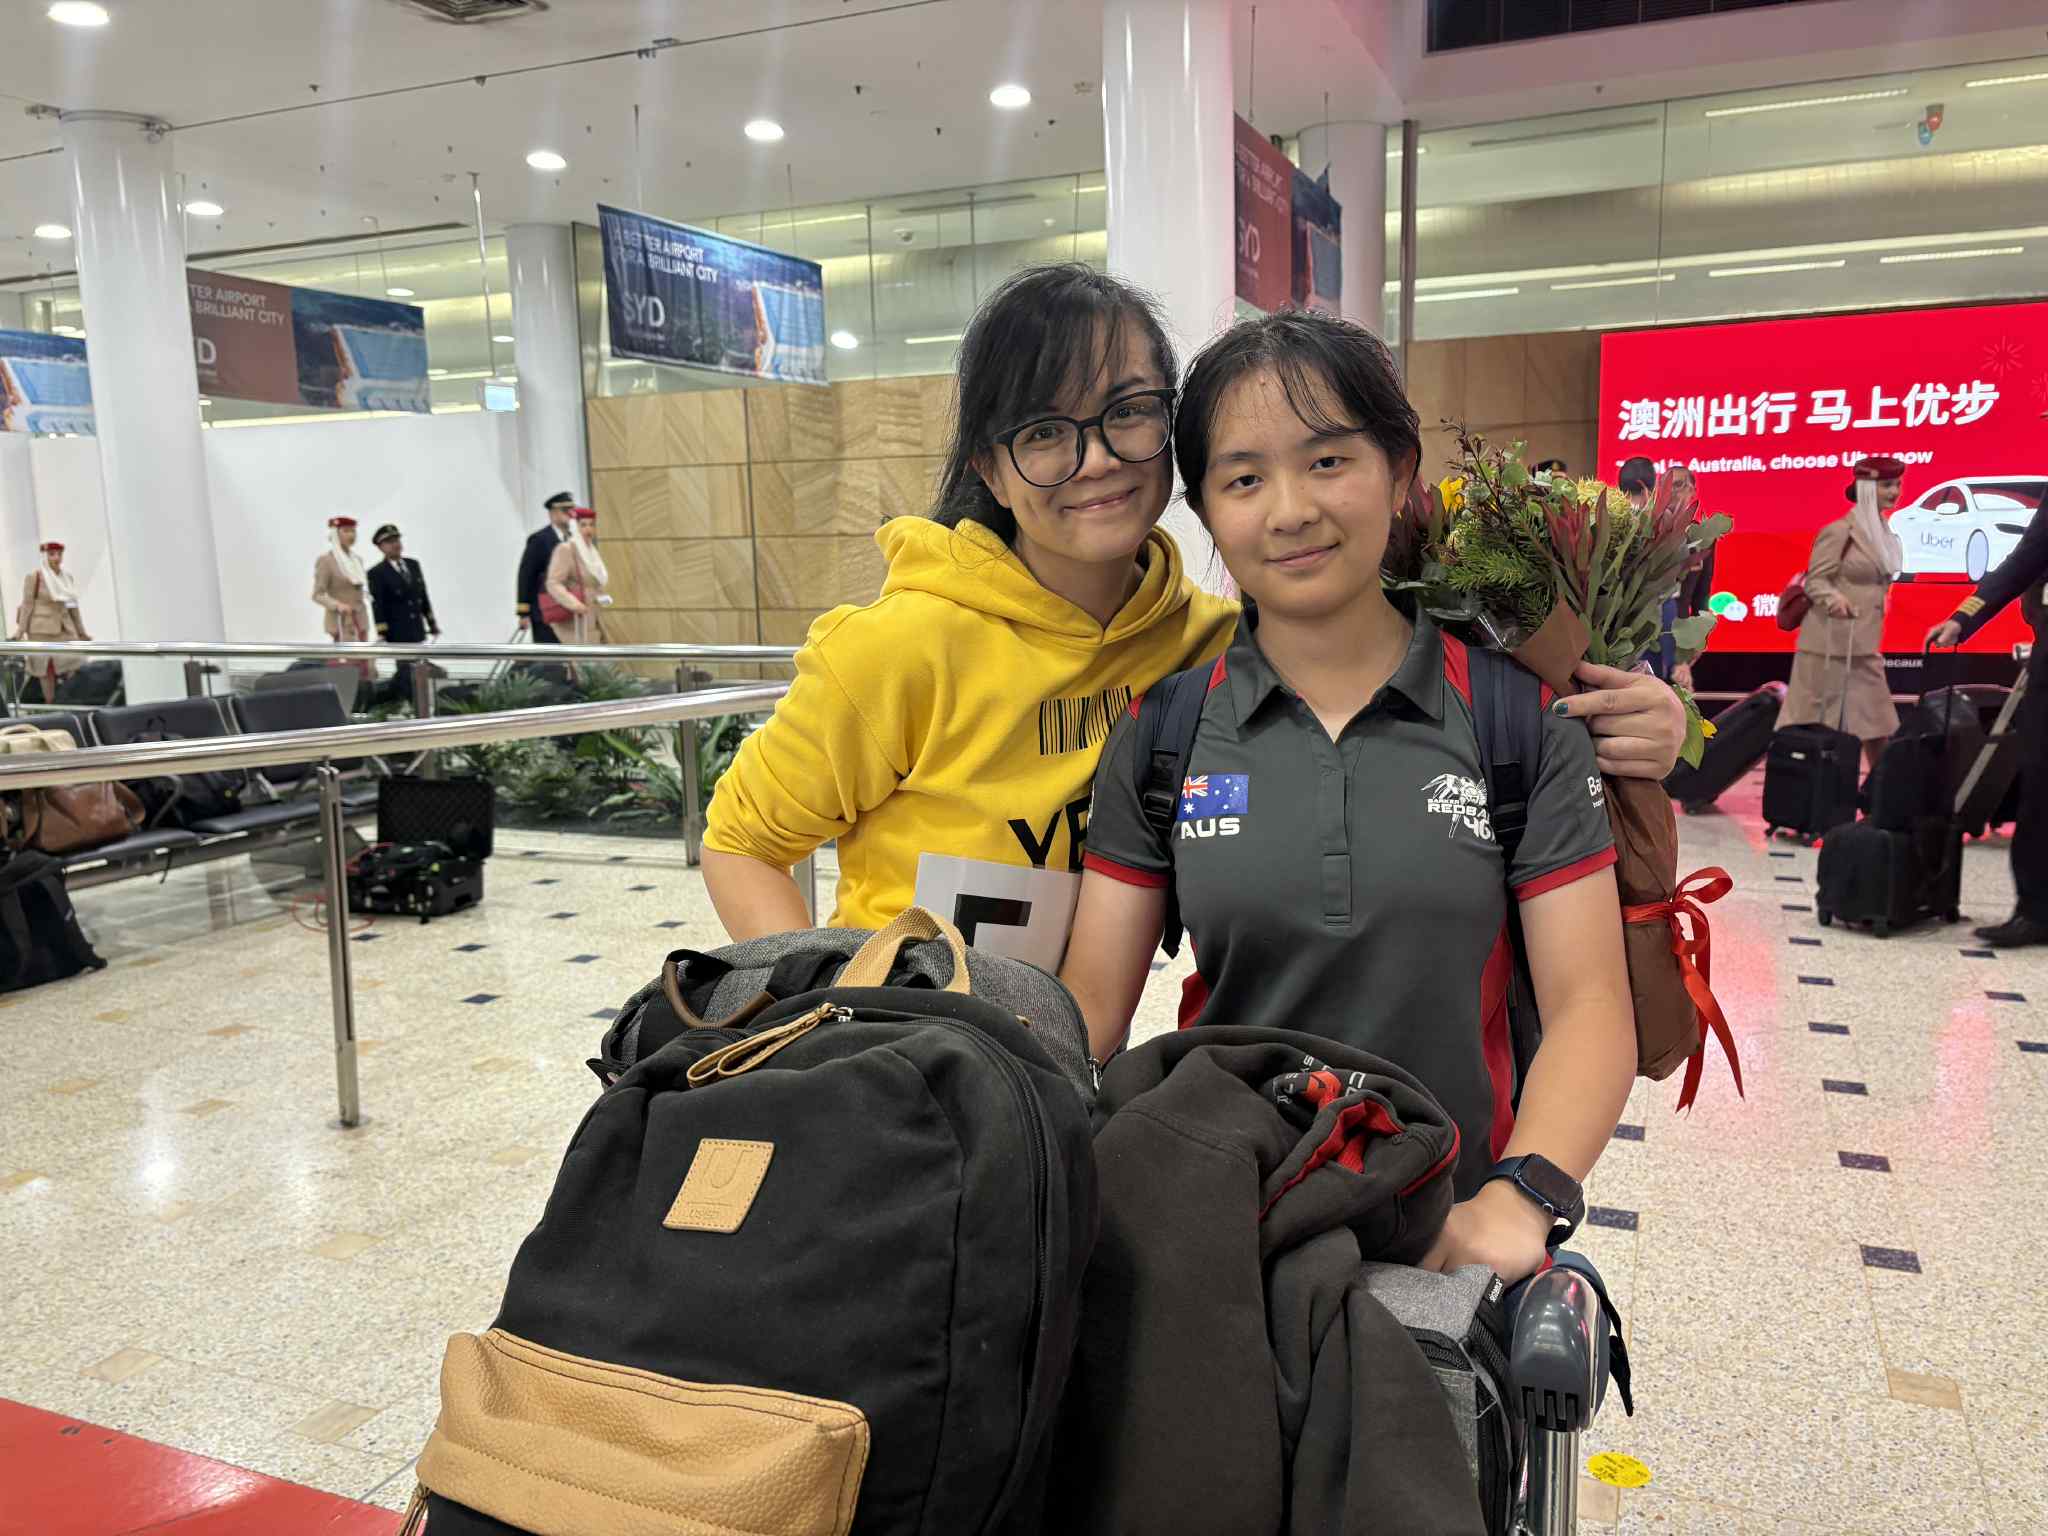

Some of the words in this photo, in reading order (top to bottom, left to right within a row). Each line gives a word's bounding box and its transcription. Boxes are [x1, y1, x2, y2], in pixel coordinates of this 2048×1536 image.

[662, 239, 704, 264] AIRPORT
[648, 253, 694, 279] BRILLIANT
[695, 264, 719, 283] CITY
[215, 287, 266, 307] AIRPORT
[195, 299, 255, 321] BRILLIANT
[258, 310, 285, 326] CITY
[624, 292, 665, 327] SYD
[1617, 391, 1797, 441] 澳洲出行
[1805, 379, 2000, 432] 马上优步
[1688, 455, 1767, 473] Australia,
[1770, 453, 1839, 470] choose
[1920, 531, 1955, 549] Uber
[1427, 803, 1489, 821] REDBA
[1180, 817, 1240, 840] AUS
